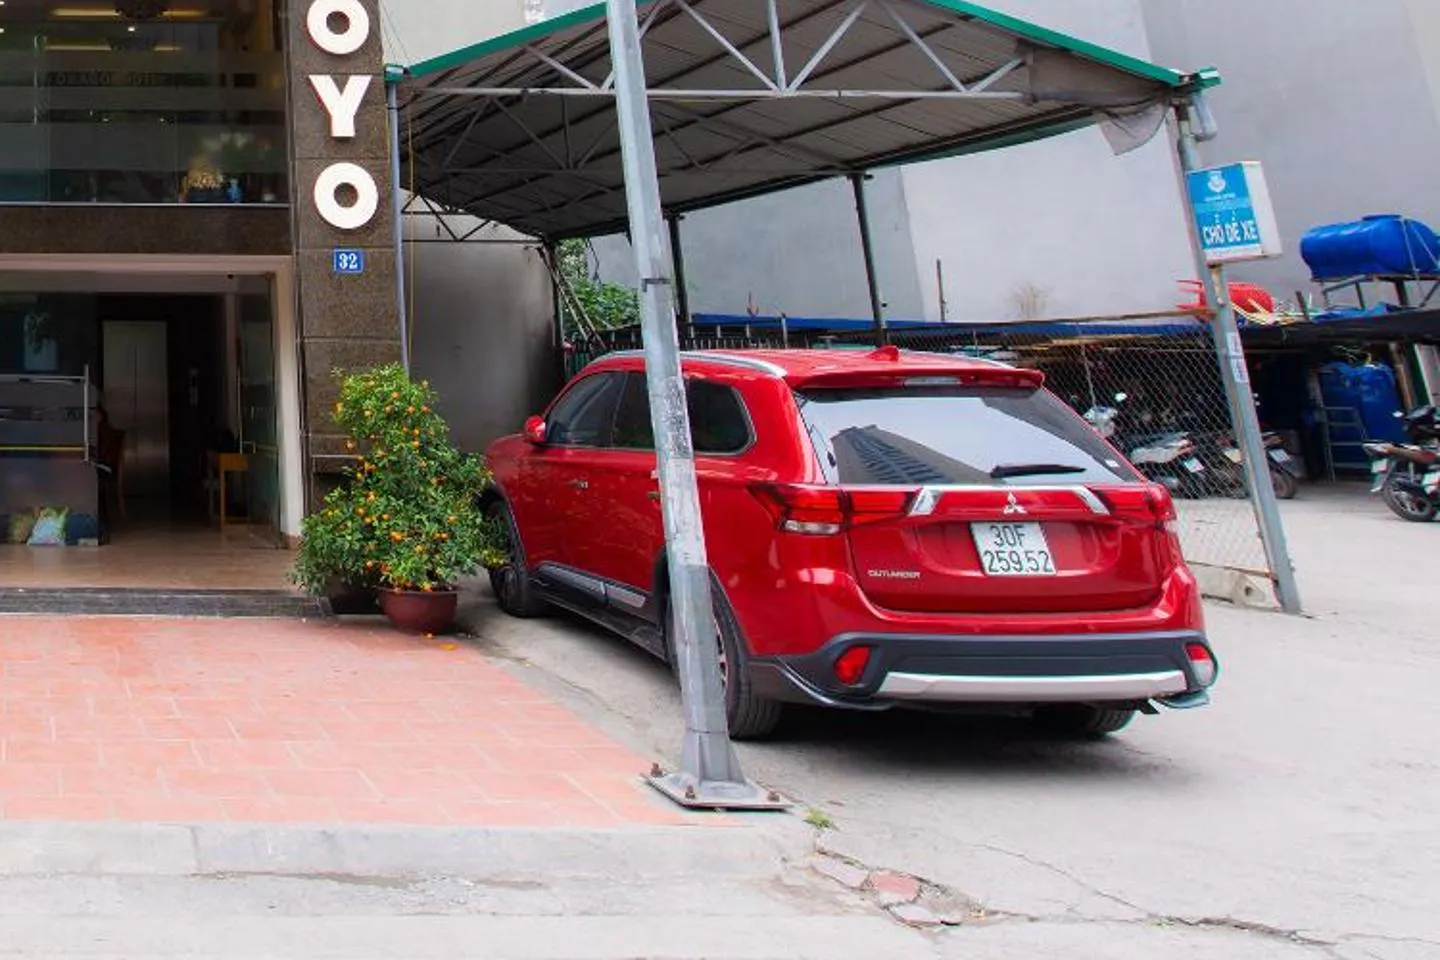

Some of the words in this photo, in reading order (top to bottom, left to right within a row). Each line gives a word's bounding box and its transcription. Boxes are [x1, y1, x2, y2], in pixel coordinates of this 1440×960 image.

[1240, 219, 1258, 241] XE
[339, 252, 358, 269] 32
[990, 524, 1026, 546] 30F
[984, 550, 1054, 573] 259.52
